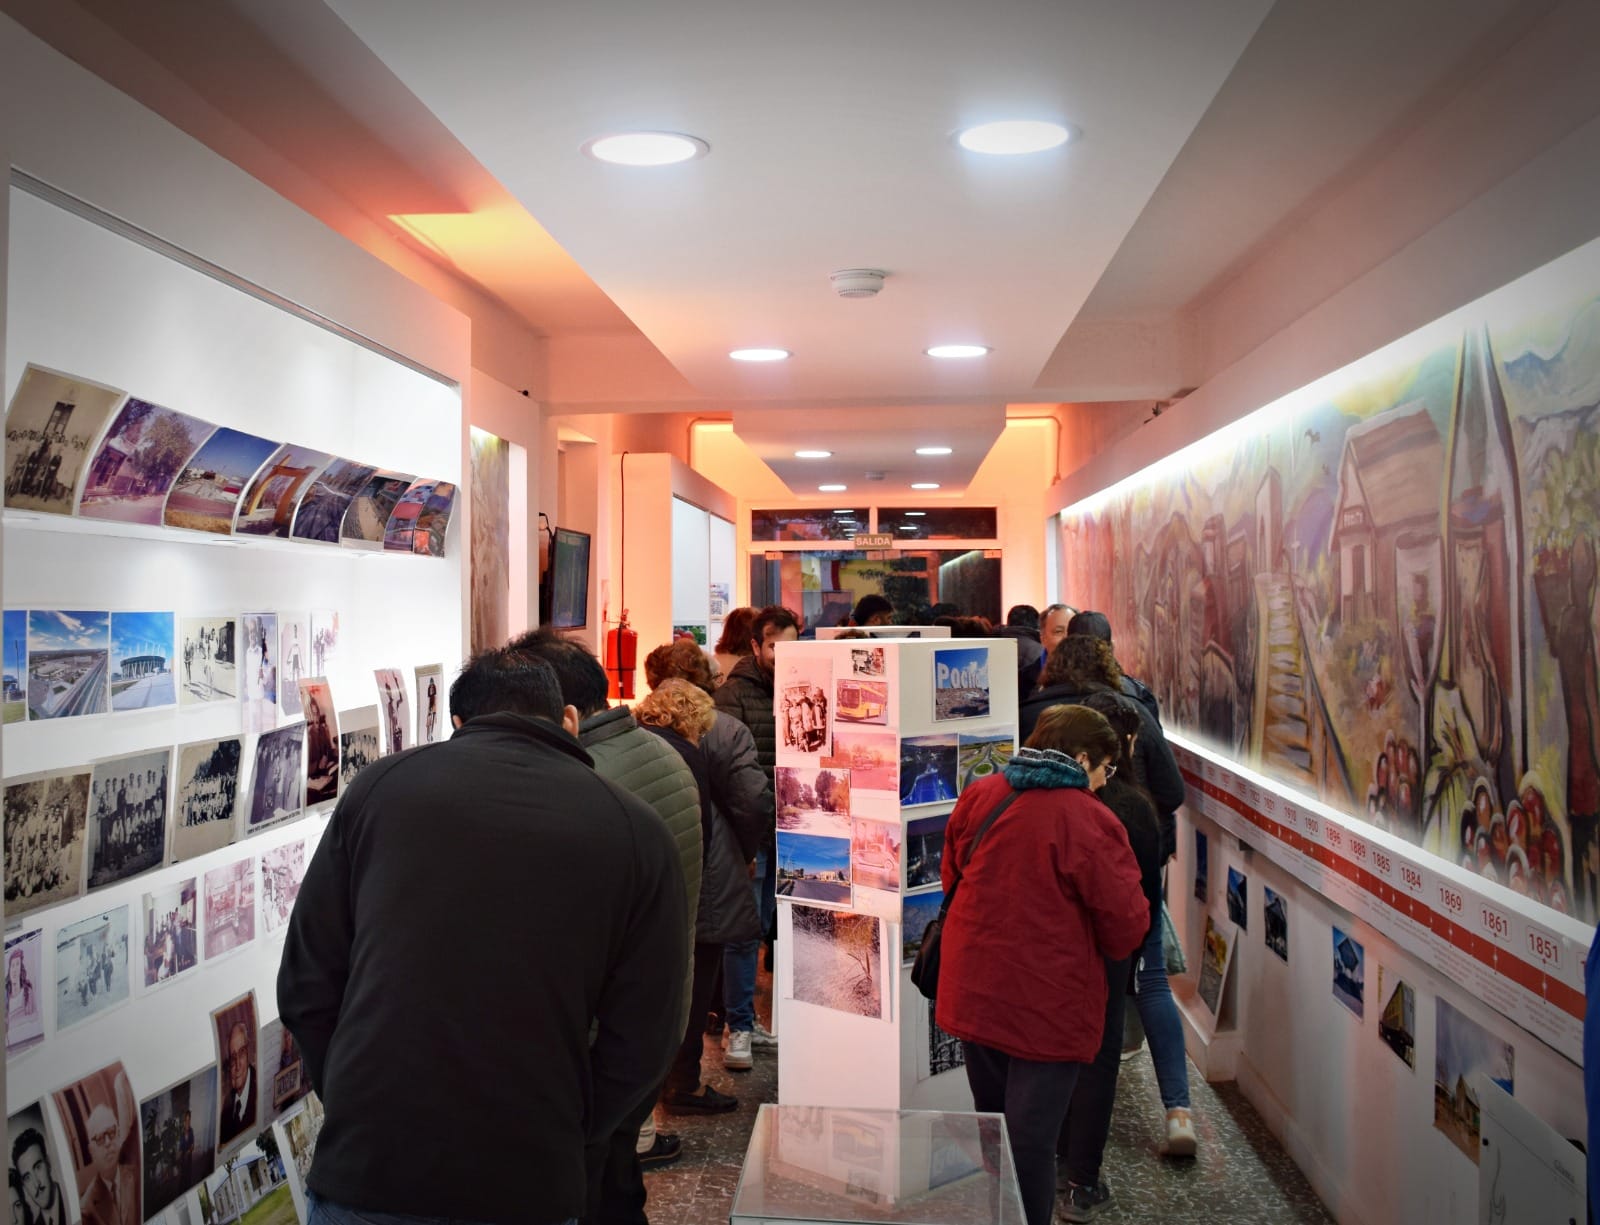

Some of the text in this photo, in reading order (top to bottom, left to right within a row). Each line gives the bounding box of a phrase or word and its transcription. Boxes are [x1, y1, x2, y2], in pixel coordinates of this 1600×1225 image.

[856, 536, 890, 545] SALIDA
[1325, 827, 1342, 844] 1896
[1350, 840, 1366, 857] 1889
[1373, 852, 1391, 872] 1885
[1401, 867, 1421, 888] 1884
[1440, 888, 1462, 911] 1869
[1482, 910, 1508, 936] 1861
[1529, 933, 1559, 962] 1851
